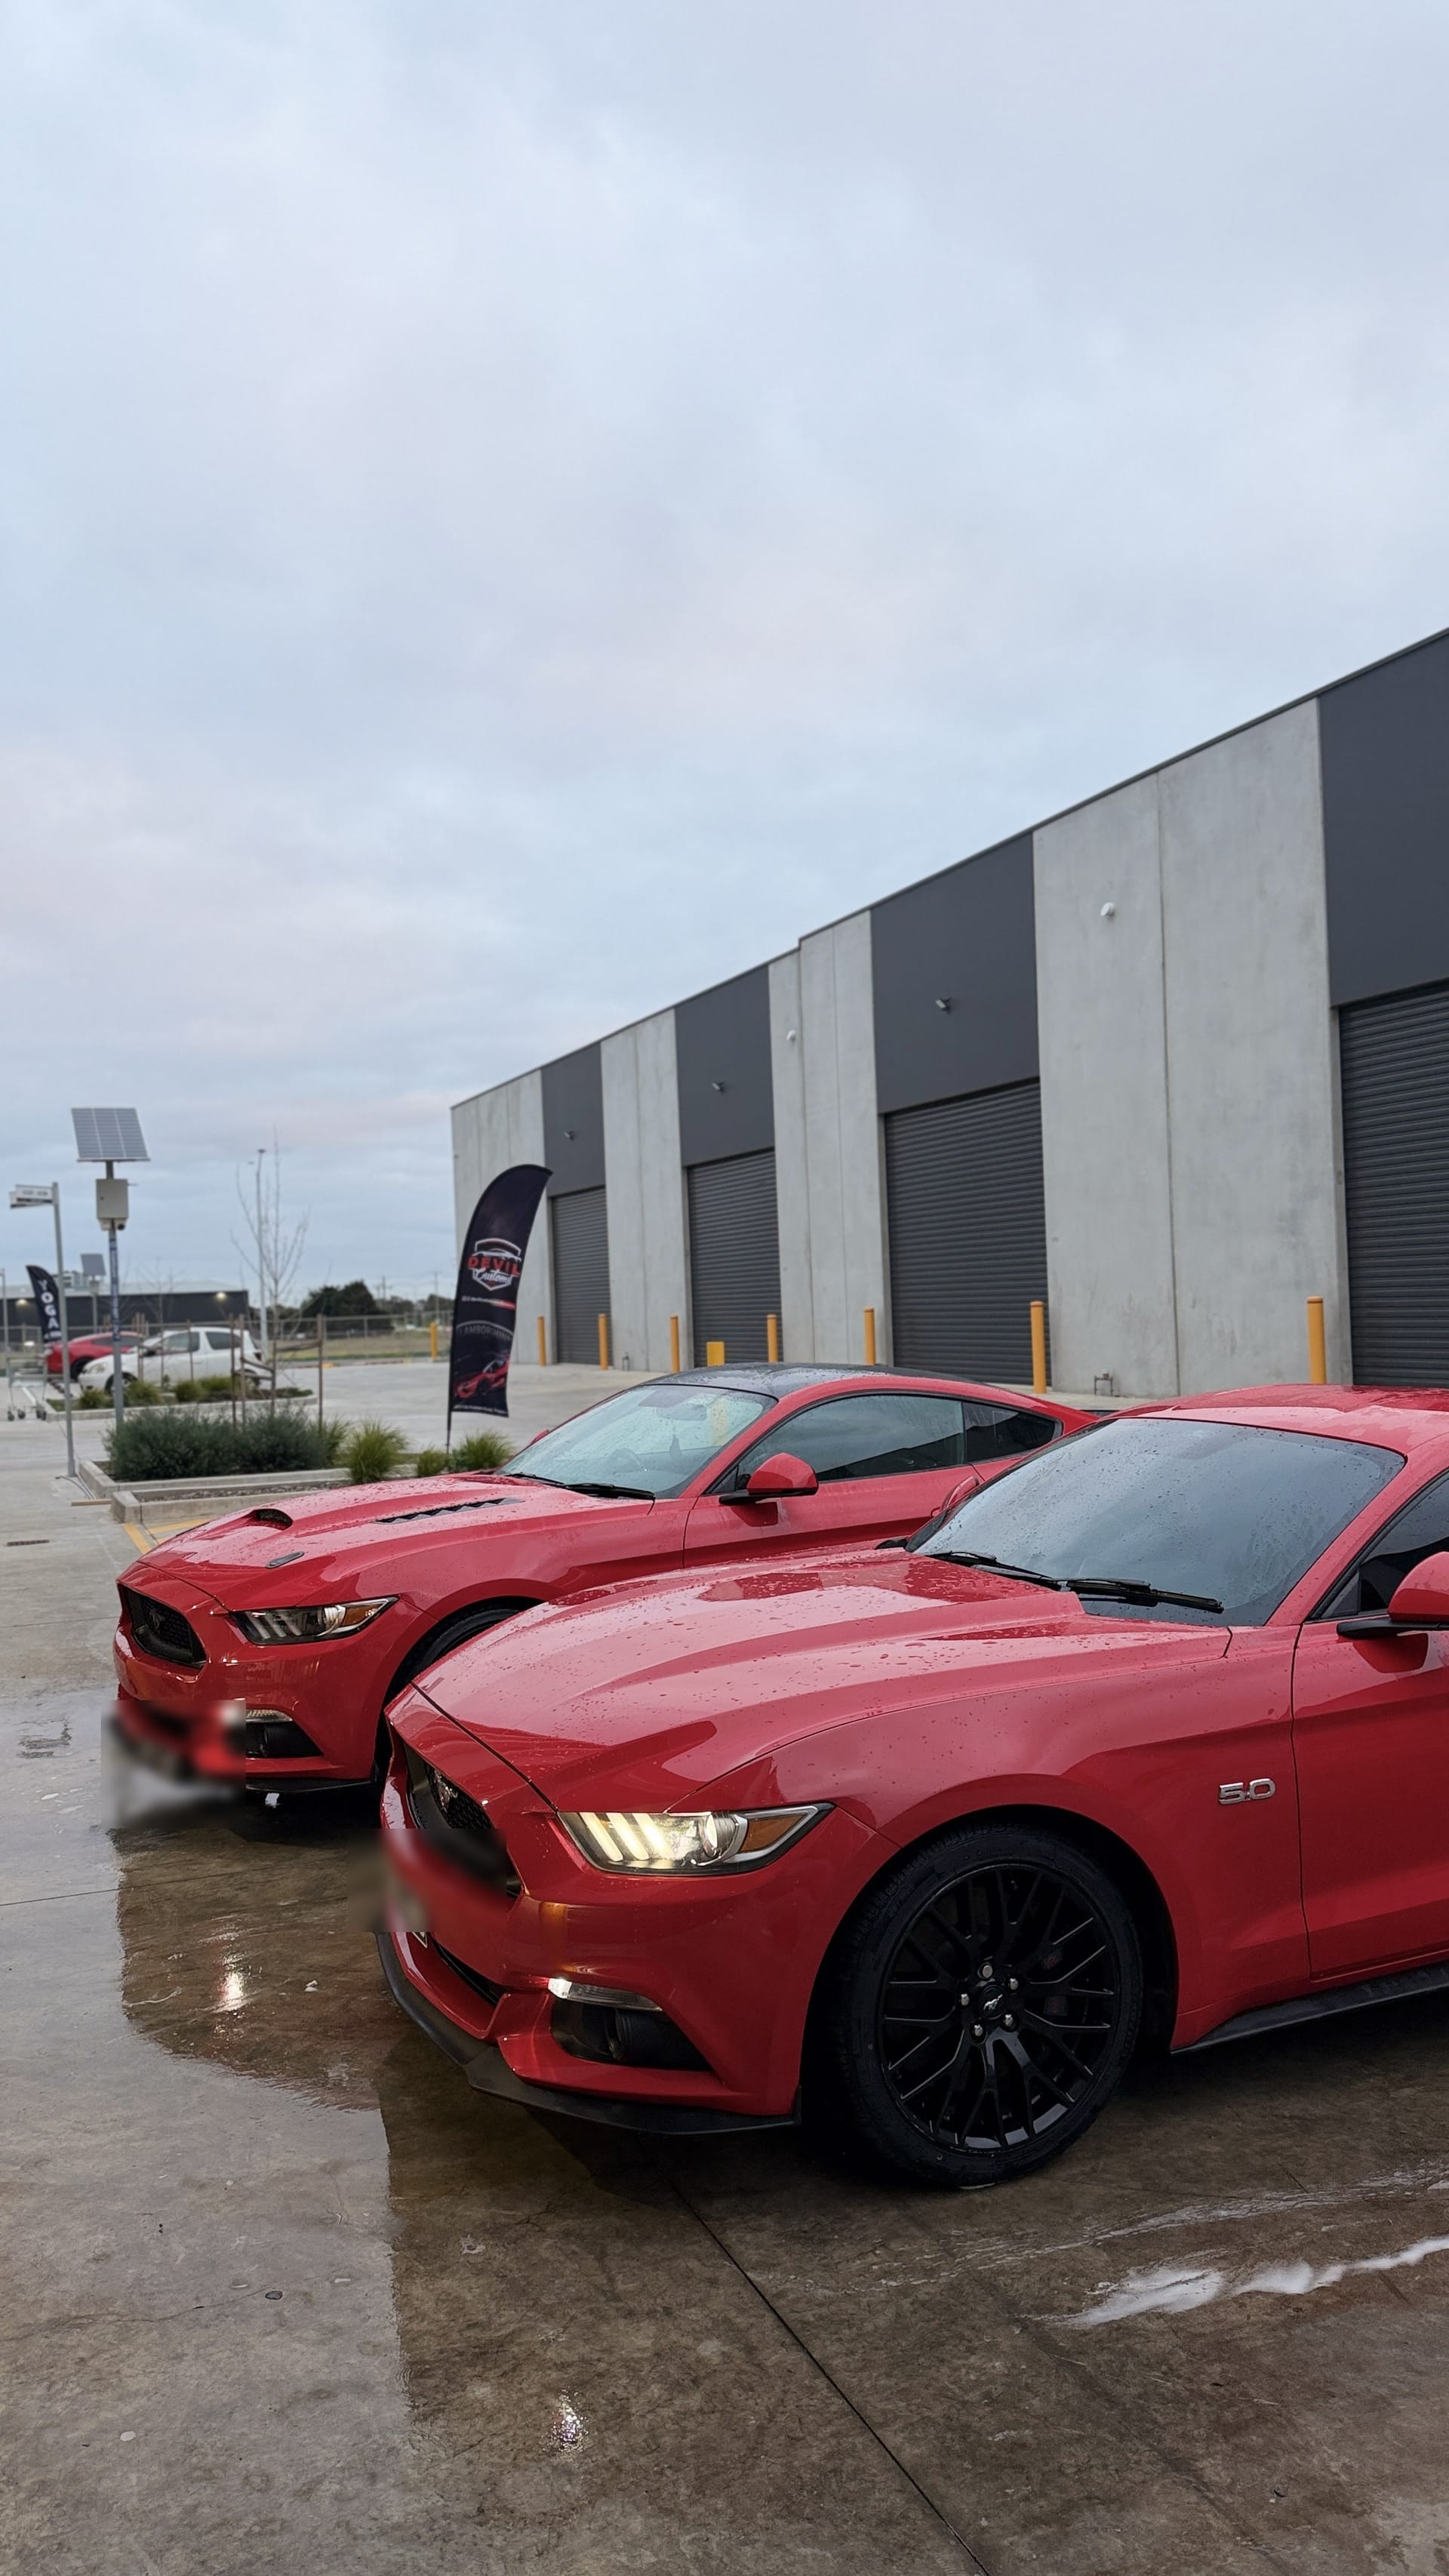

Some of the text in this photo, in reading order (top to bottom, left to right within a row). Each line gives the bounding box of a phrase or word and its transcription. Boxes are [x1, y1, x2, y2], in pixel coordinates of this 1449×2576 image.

[468, 1257, 520, 1276] DEVIL
[38, 1279, 60, 1328] YOGA
[1218, 1778, 1275, 1805] 5.0
